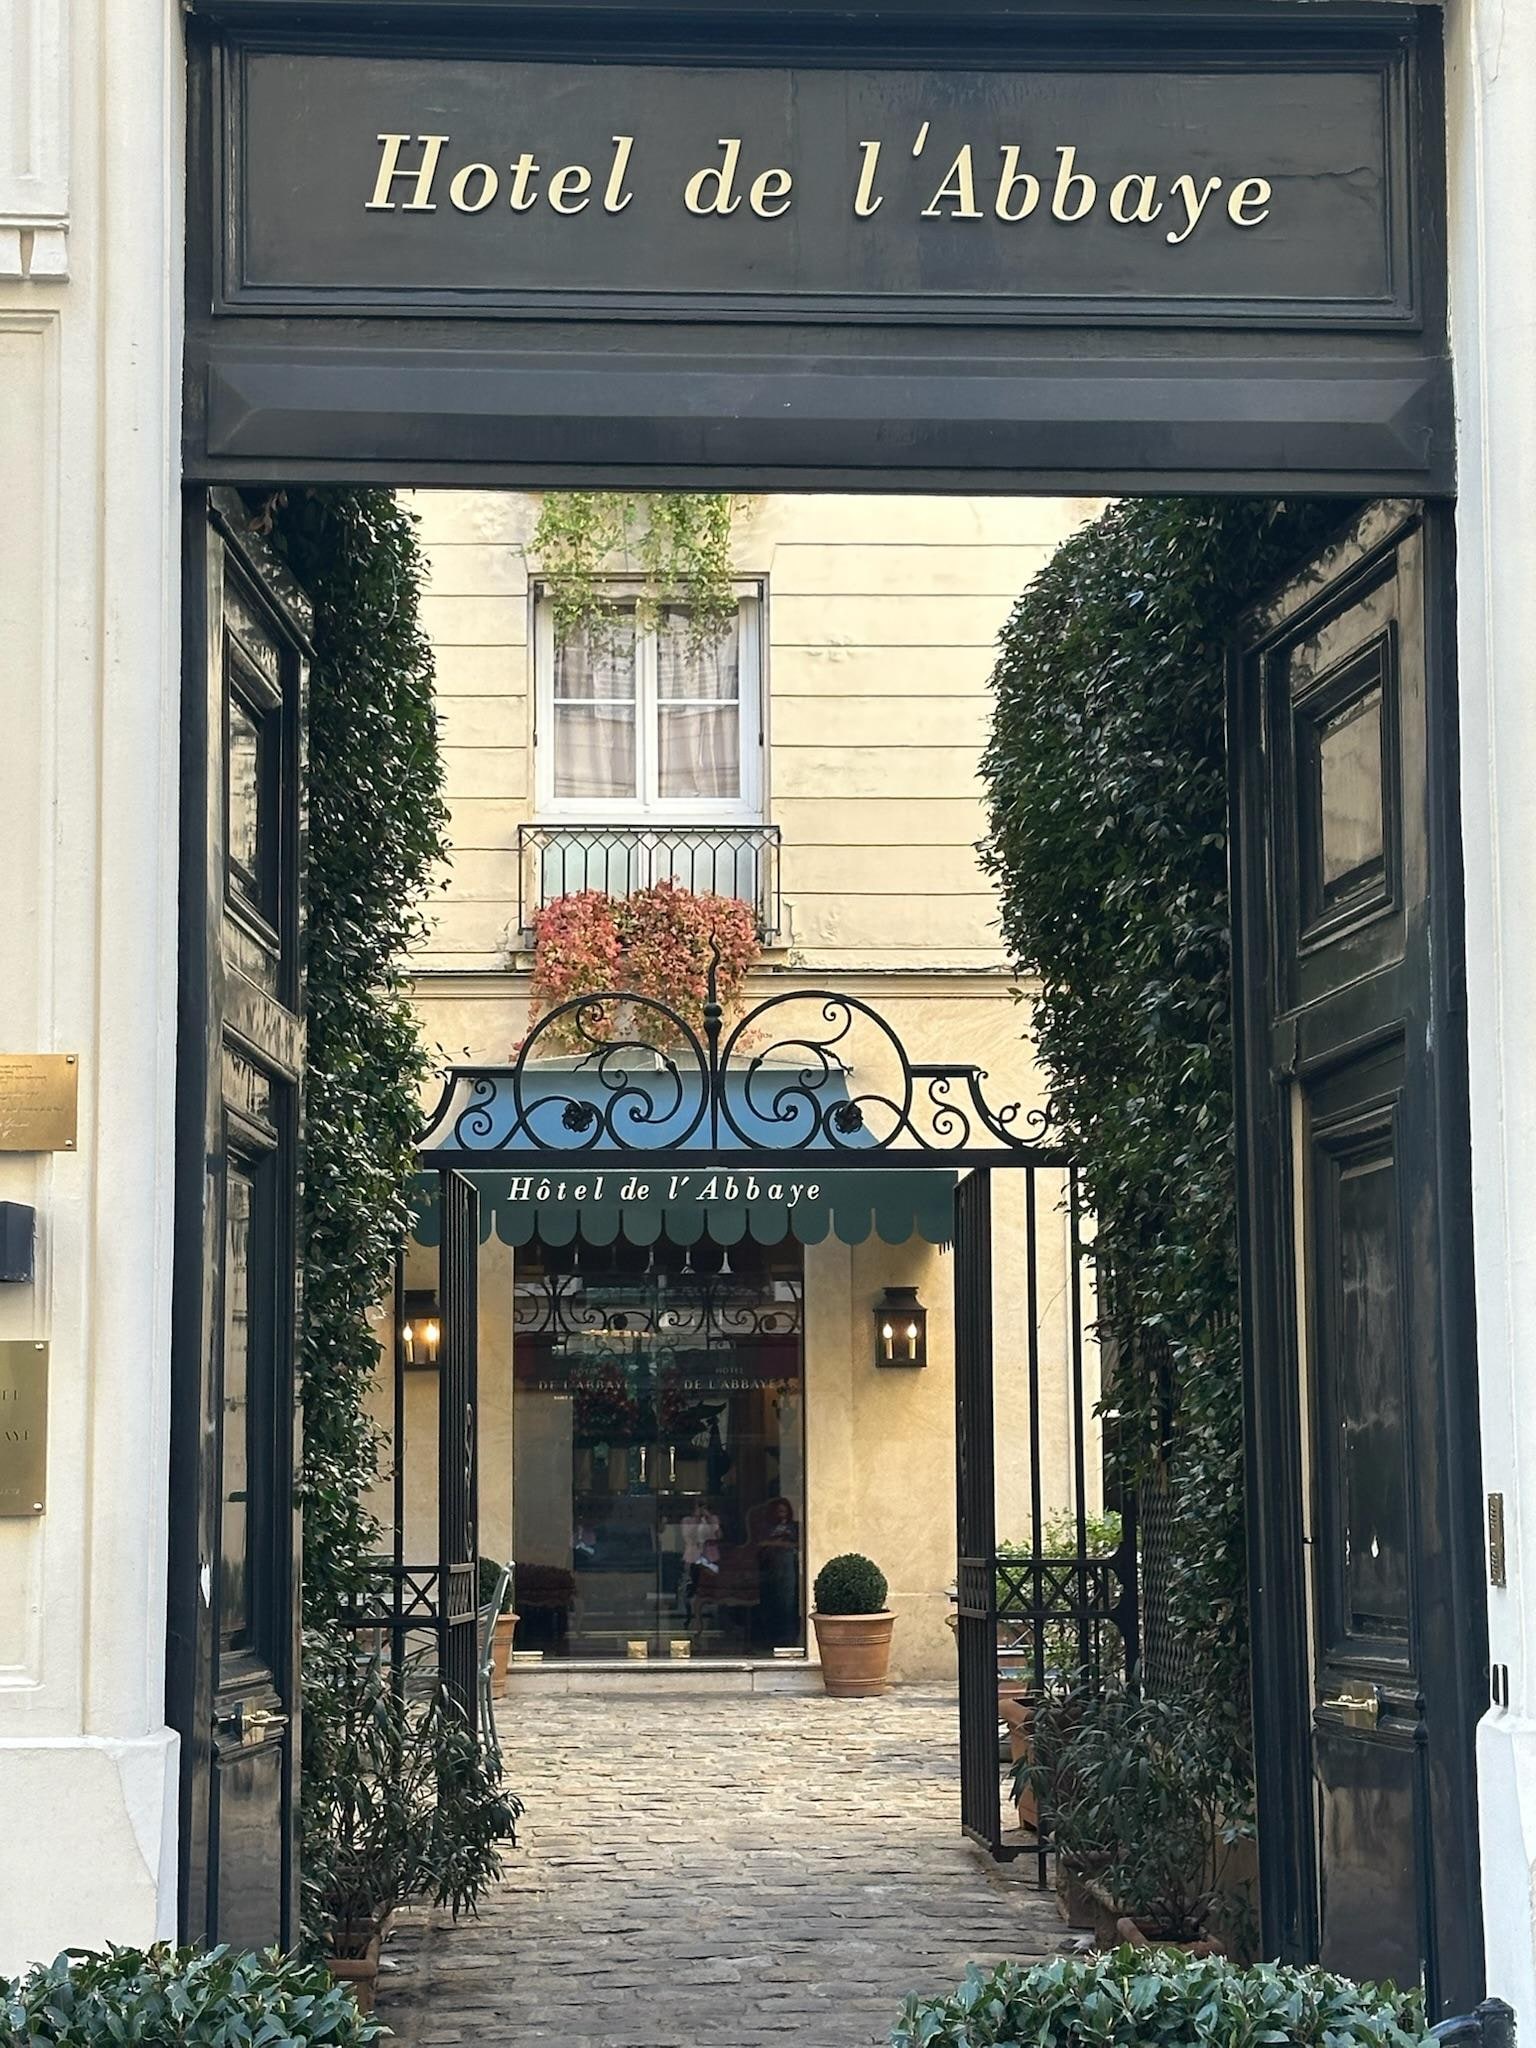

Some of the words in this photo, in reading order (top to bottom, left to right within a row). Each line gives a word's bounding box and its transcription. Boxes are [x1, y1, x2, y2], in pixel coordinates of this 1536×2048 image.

[365, 134, 633, 213] Hotel
[685, 139, 791, 217] de
[855, 122, 1271, 243] l'Abbaye
[507, 1177, 603, 1200] Hôtel
[621, 1177, 649, 1200] de
[684, 1379, 702, 1390] DE
